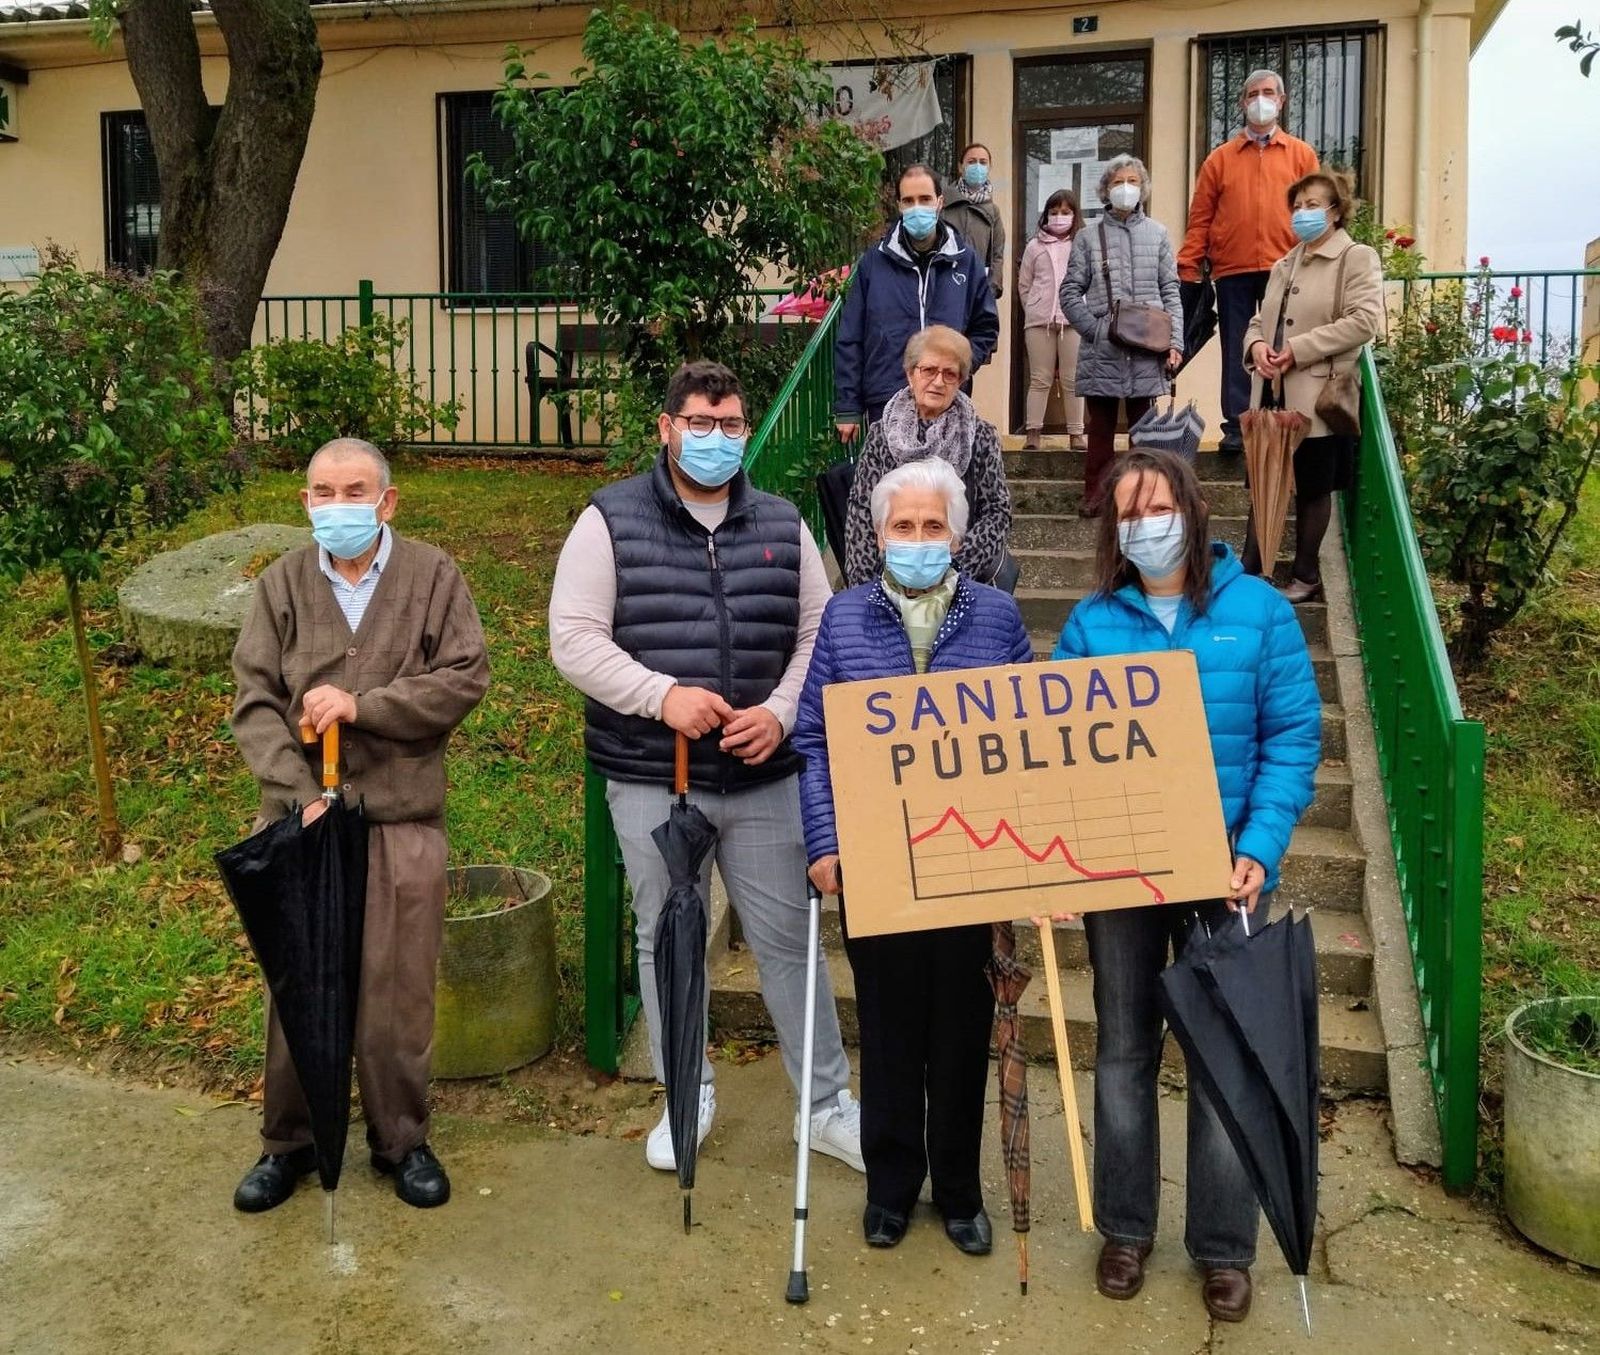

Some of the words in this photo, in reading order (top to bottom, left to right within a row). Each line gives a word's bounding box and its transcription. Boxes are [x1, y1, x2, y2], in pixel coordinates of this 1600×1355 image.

[1080, 17, 1089, 32] 2
[865, 664, 1161, 736] SANIDAD
[891, 718, 1157, 786] PÚBLICA
